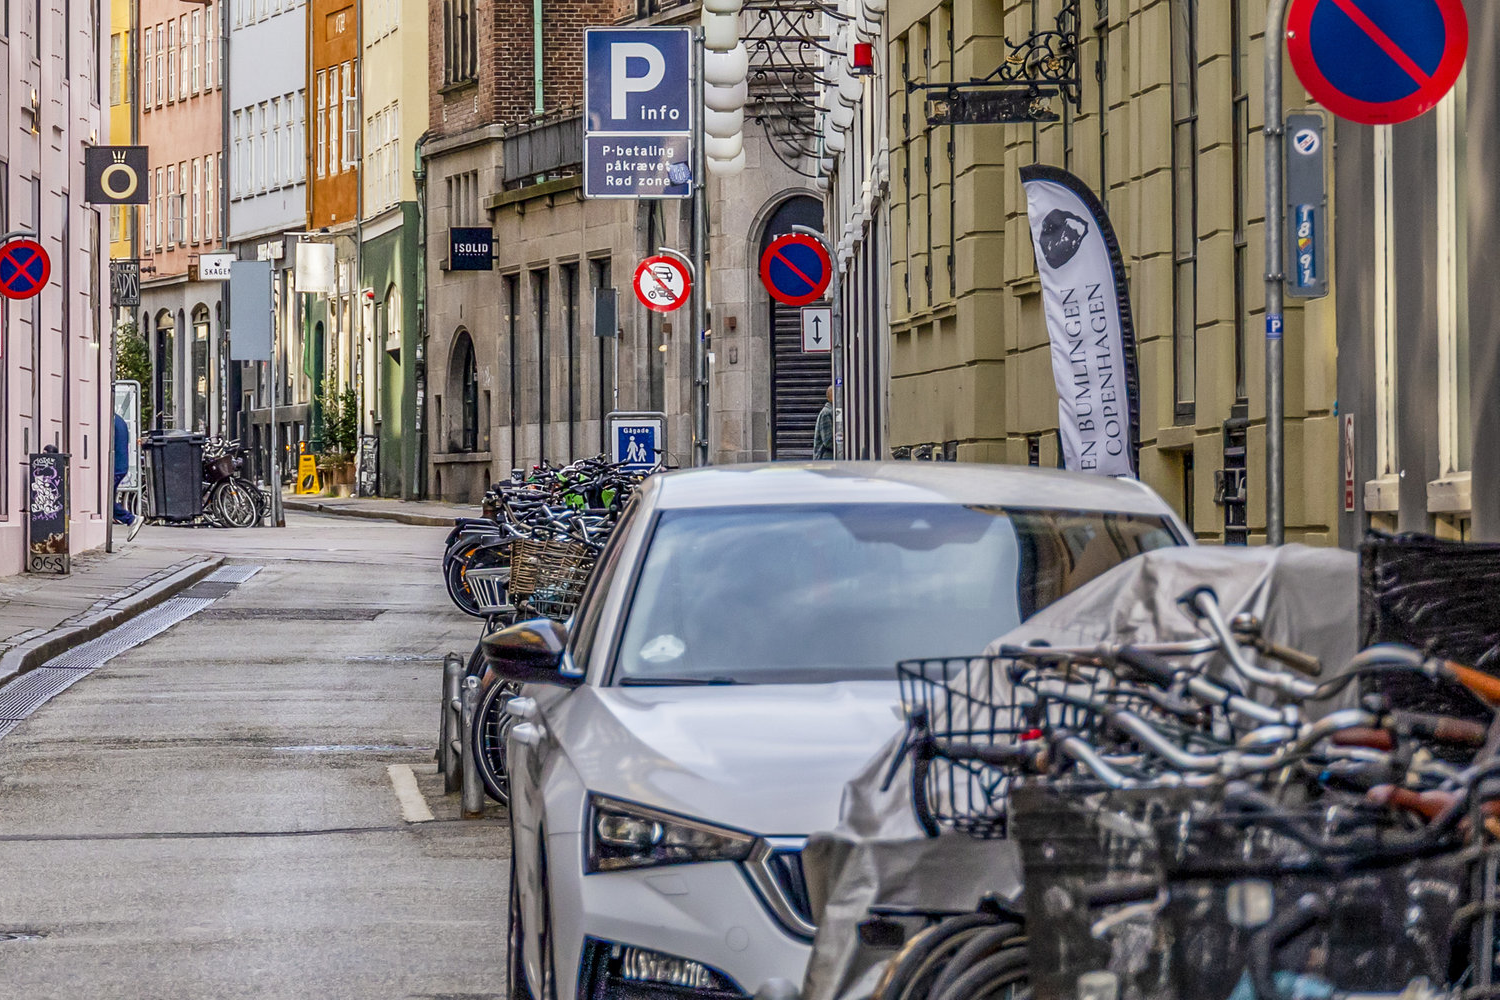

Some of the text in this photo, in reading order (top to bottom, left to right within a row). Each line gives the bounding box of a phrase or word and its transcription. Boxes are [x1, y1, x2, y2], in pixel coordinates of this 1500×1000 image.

[611, 42, 666, 120] P
[641, 105, 680, 120] info
[602, 146, 674, 157] P-betaling
[606, 161, 671, 172] påkrævet
[606, 175, 671, 186] Rød zone
[1060, 288, 1096, 433] BUMLINGEN
[1085, 282, 1123, 456] COPENHAGEN
[623, 427, 649, 435] Gågade
